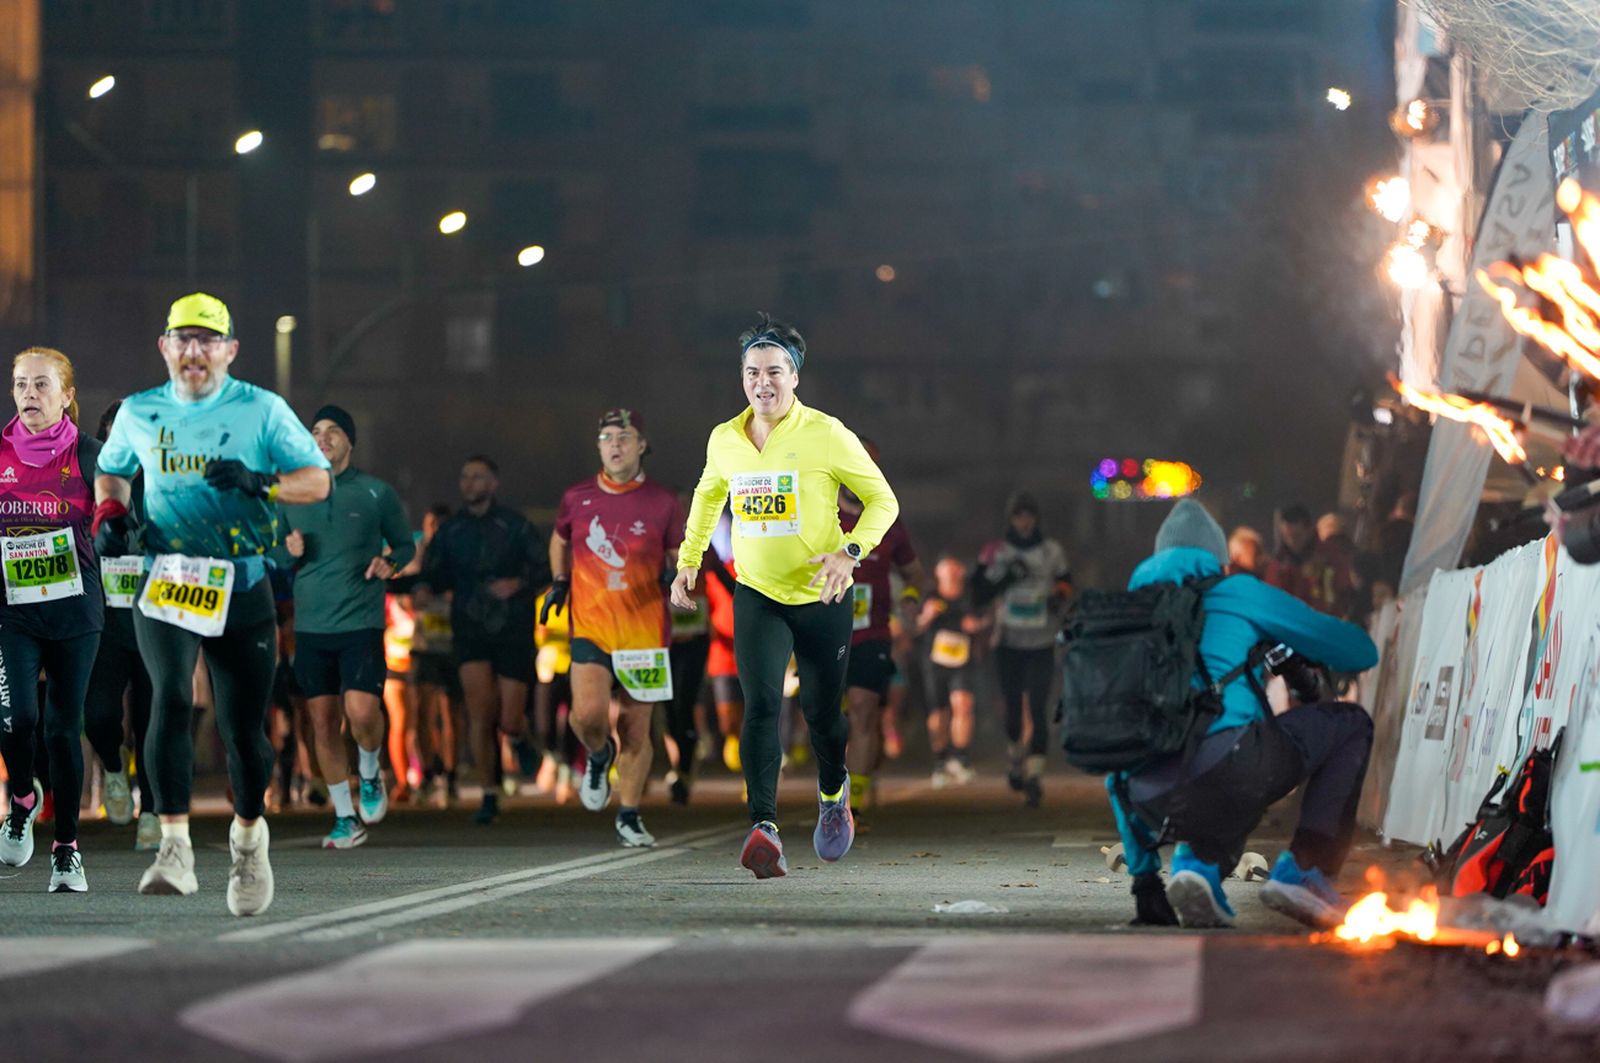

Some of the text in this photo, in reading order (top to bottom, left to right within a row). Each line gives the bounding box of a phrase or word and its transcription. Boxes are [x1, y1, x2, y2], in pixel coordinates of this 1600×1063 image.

[742, 494, 786, 515] 4526
[9, 550, 24, 560] SAN
[15, 541, 37, 551] NOCHE
[12, 555, 69, 581] 12678
[3, 716, 13, 734] LA
